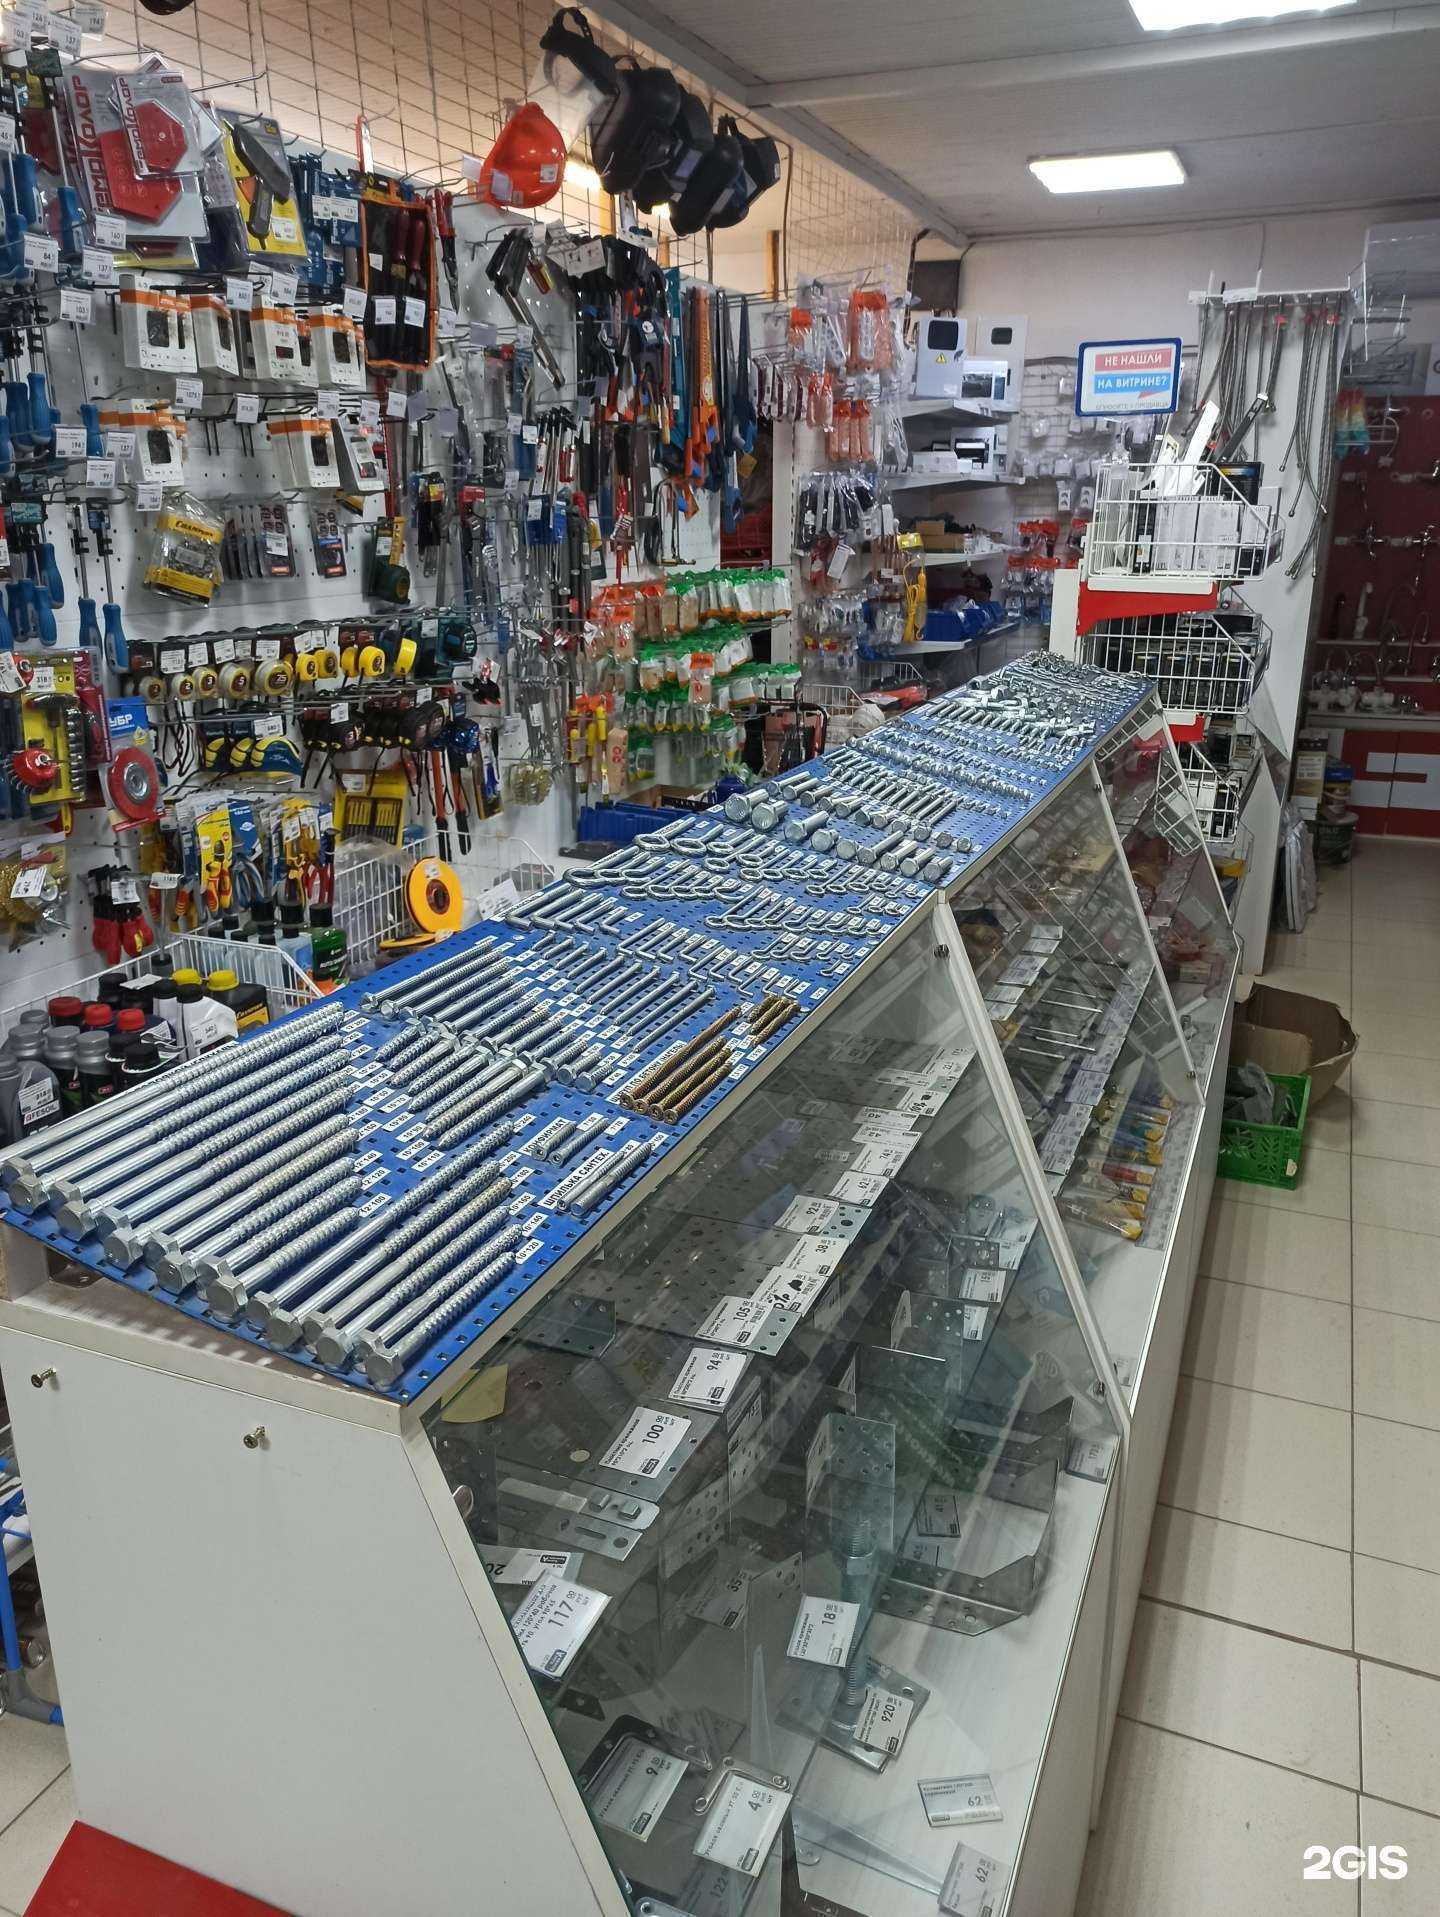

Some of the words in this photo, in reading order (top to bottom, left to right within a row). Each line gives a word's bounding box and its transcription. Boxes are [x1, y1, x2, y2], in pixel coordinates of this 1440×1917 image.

[1104, 356, 1118, 366] НЕ
[1120, 351, 1162, 366] НАШЛИ
[1097, 380, 1112, 389] НА
[1116, 375, 1168, 388] ВИТРИНЕ?
[522, 1118, 568, 1155] КОНФИРМАТ
[543, 1174, 581, 1206] ШПИЛЬКА
[579, 1150, 610, 1176] САНТЕХ.
[806, 1204, 819, 1216] 92
[815, 1243, 829, 1254] 38
[732, 1307, 751, 1322] 105
[706, 1359, 722, 1372] 94
[642, 1424, 665, 1445] 100
[548, 1599, 574, 1627] 117
[821, 1609, 837, 1625] 18
[881, 1703, 897, 1724] 920
[645, 1765, 659, 1776] 9
[747, 1799, 763, 1812] 4
[967, 1795, 983, 1807] 62
[975, 1866, 990, 1884] 62
[709, 1875, 730, 1898] 122
